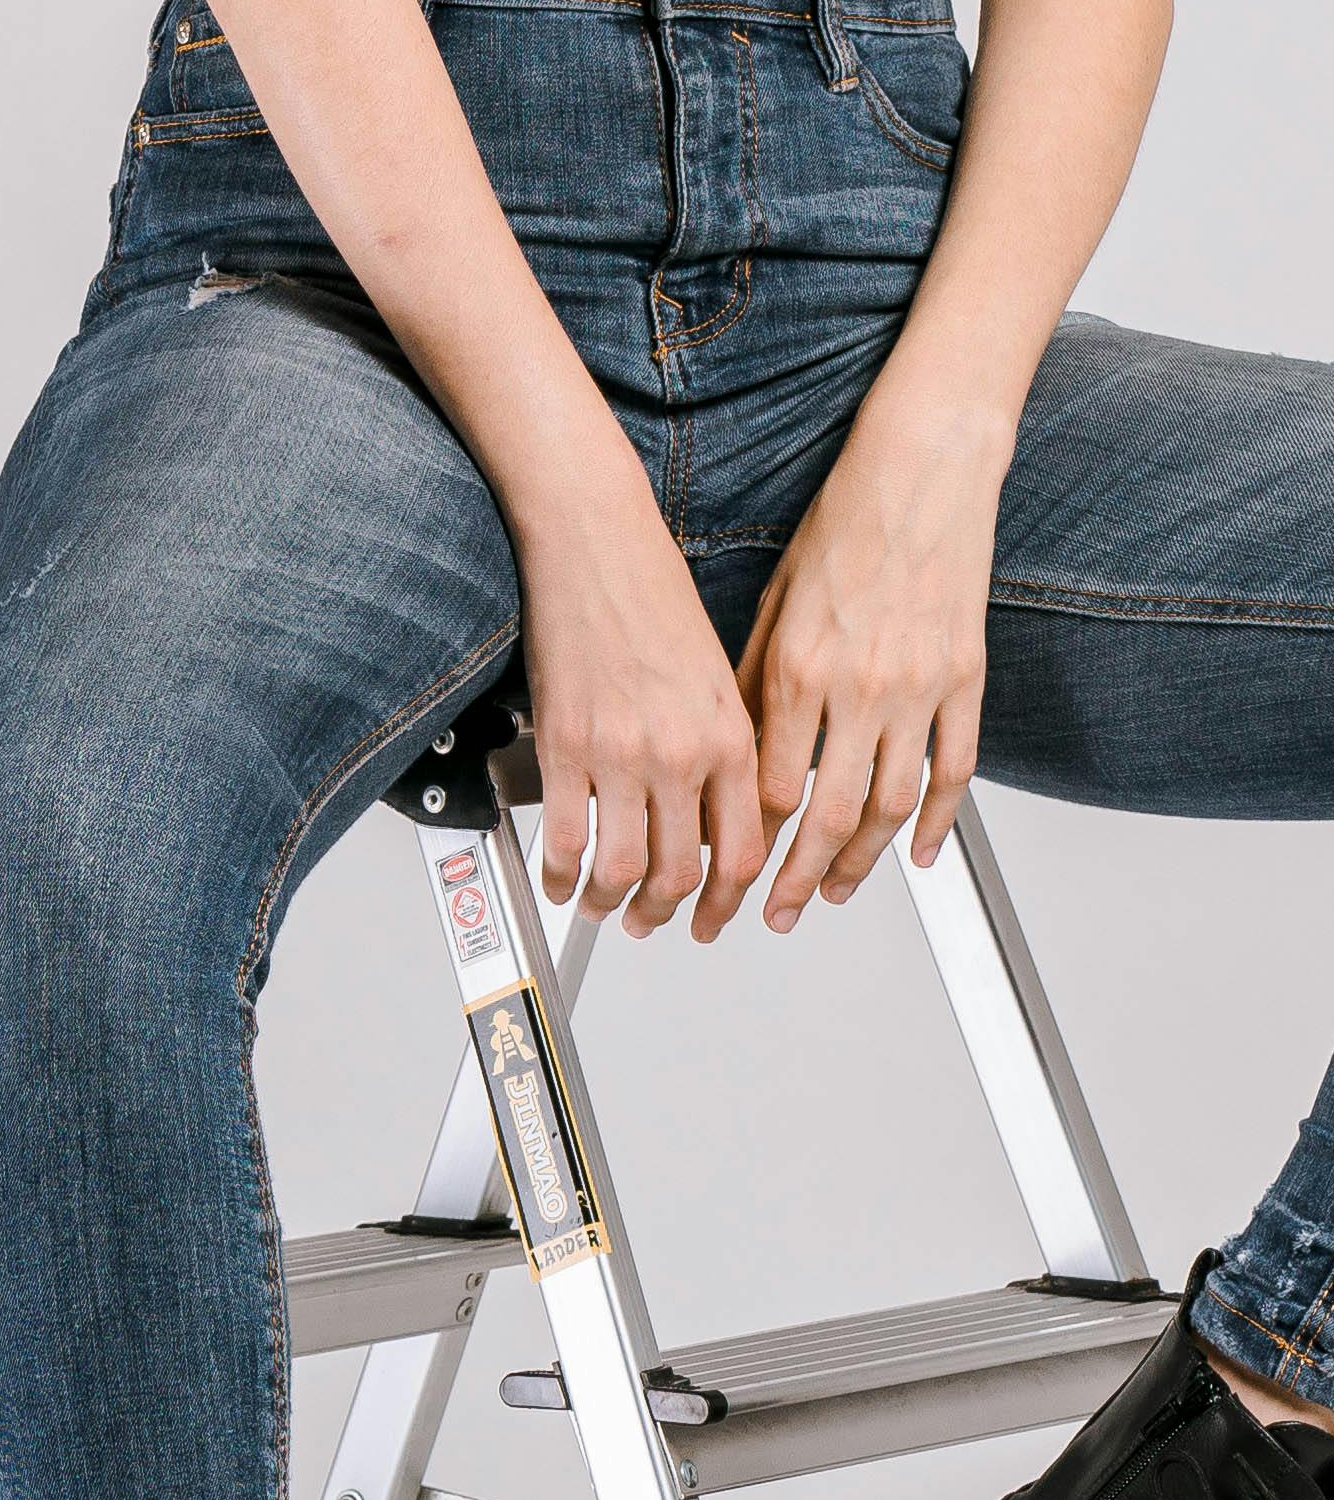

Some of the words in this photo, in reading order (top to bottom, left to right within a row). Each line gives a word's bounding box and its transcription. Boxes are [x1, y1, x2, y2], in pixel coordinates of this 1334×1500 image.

[443, 860, 471, 876] DANGER
[505, 1072, 566, 1223] JINMAO
[531, 1229, 602, 1271] LADDER
